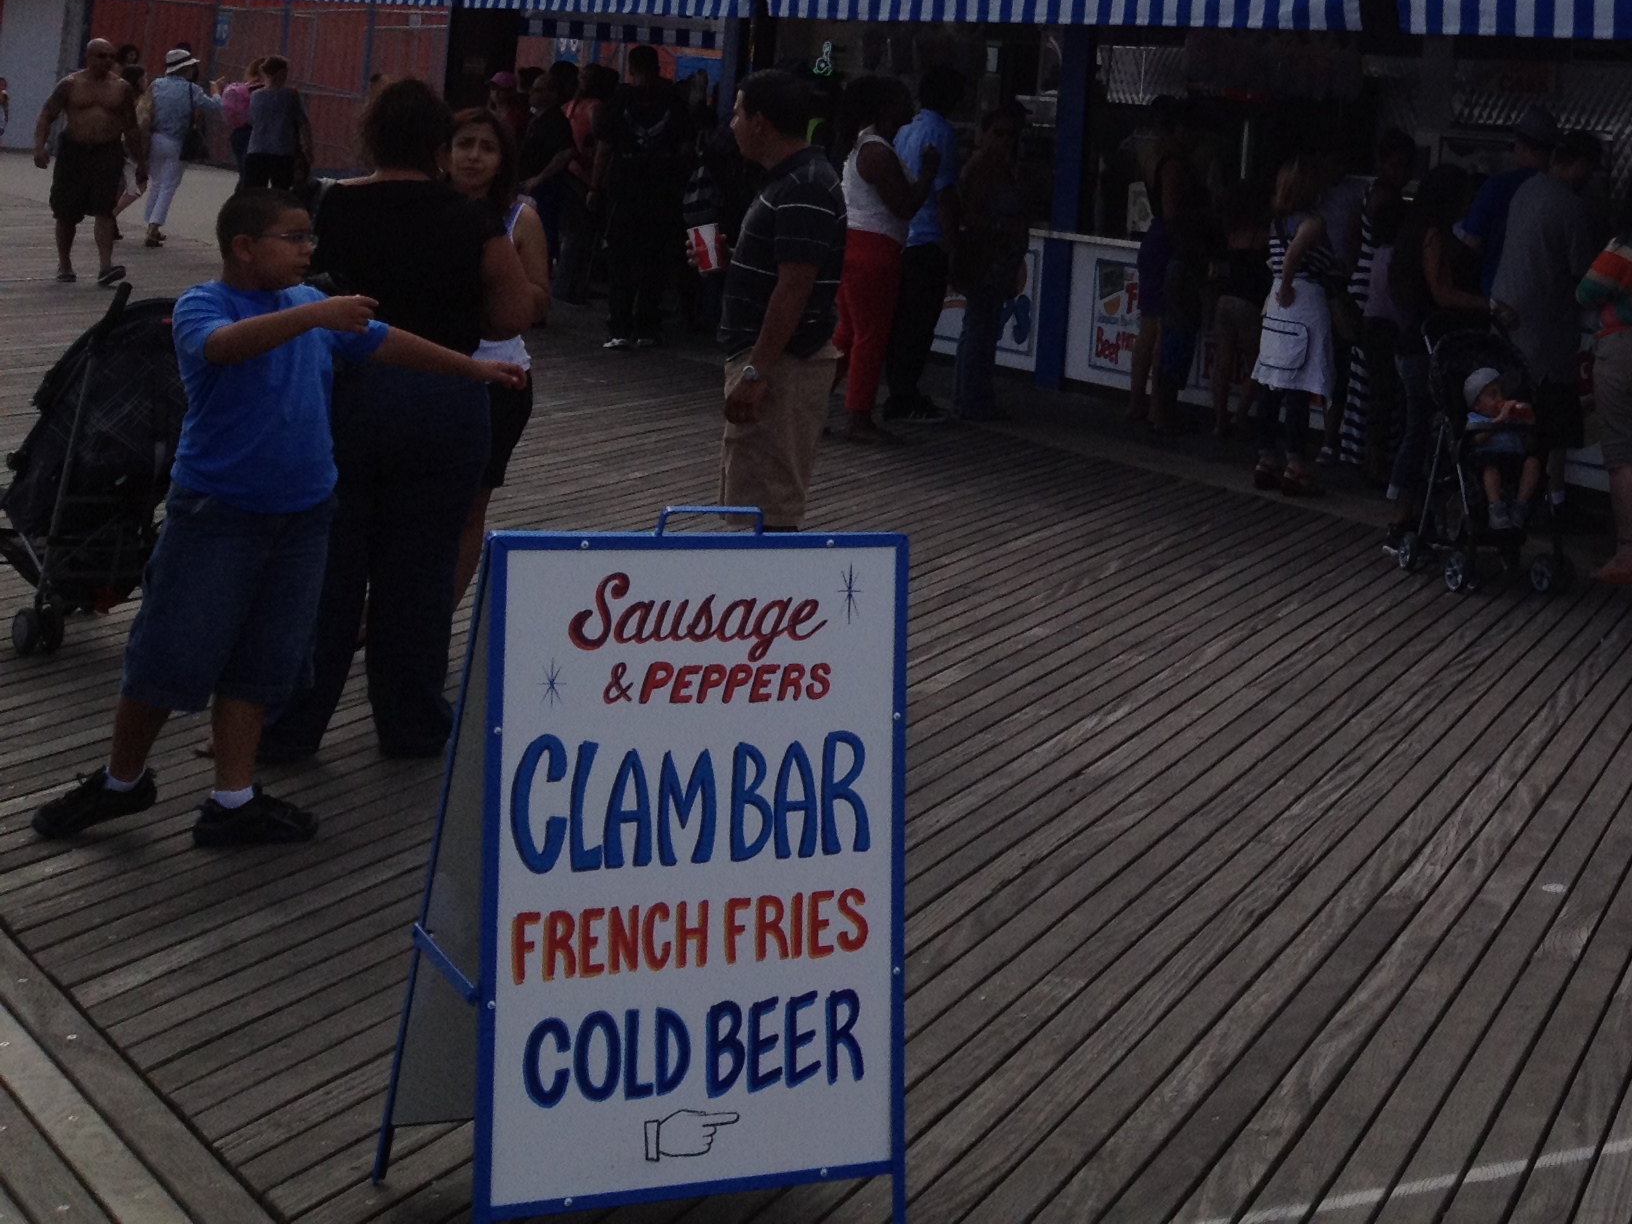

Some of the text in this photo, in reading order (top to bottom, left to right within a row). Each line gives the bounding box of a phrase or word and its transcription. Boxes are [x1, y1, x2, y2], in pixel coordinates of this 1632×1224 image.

[568, 572, 828, 662] Sausage
[603, 661, 832, 705] & PEPPERS
[510, 730, 871, 874] CLAM BAR
[510, 887, 869, 986] FRENCH FRIES
[522, 988, 865, 1109] COLD BEER
